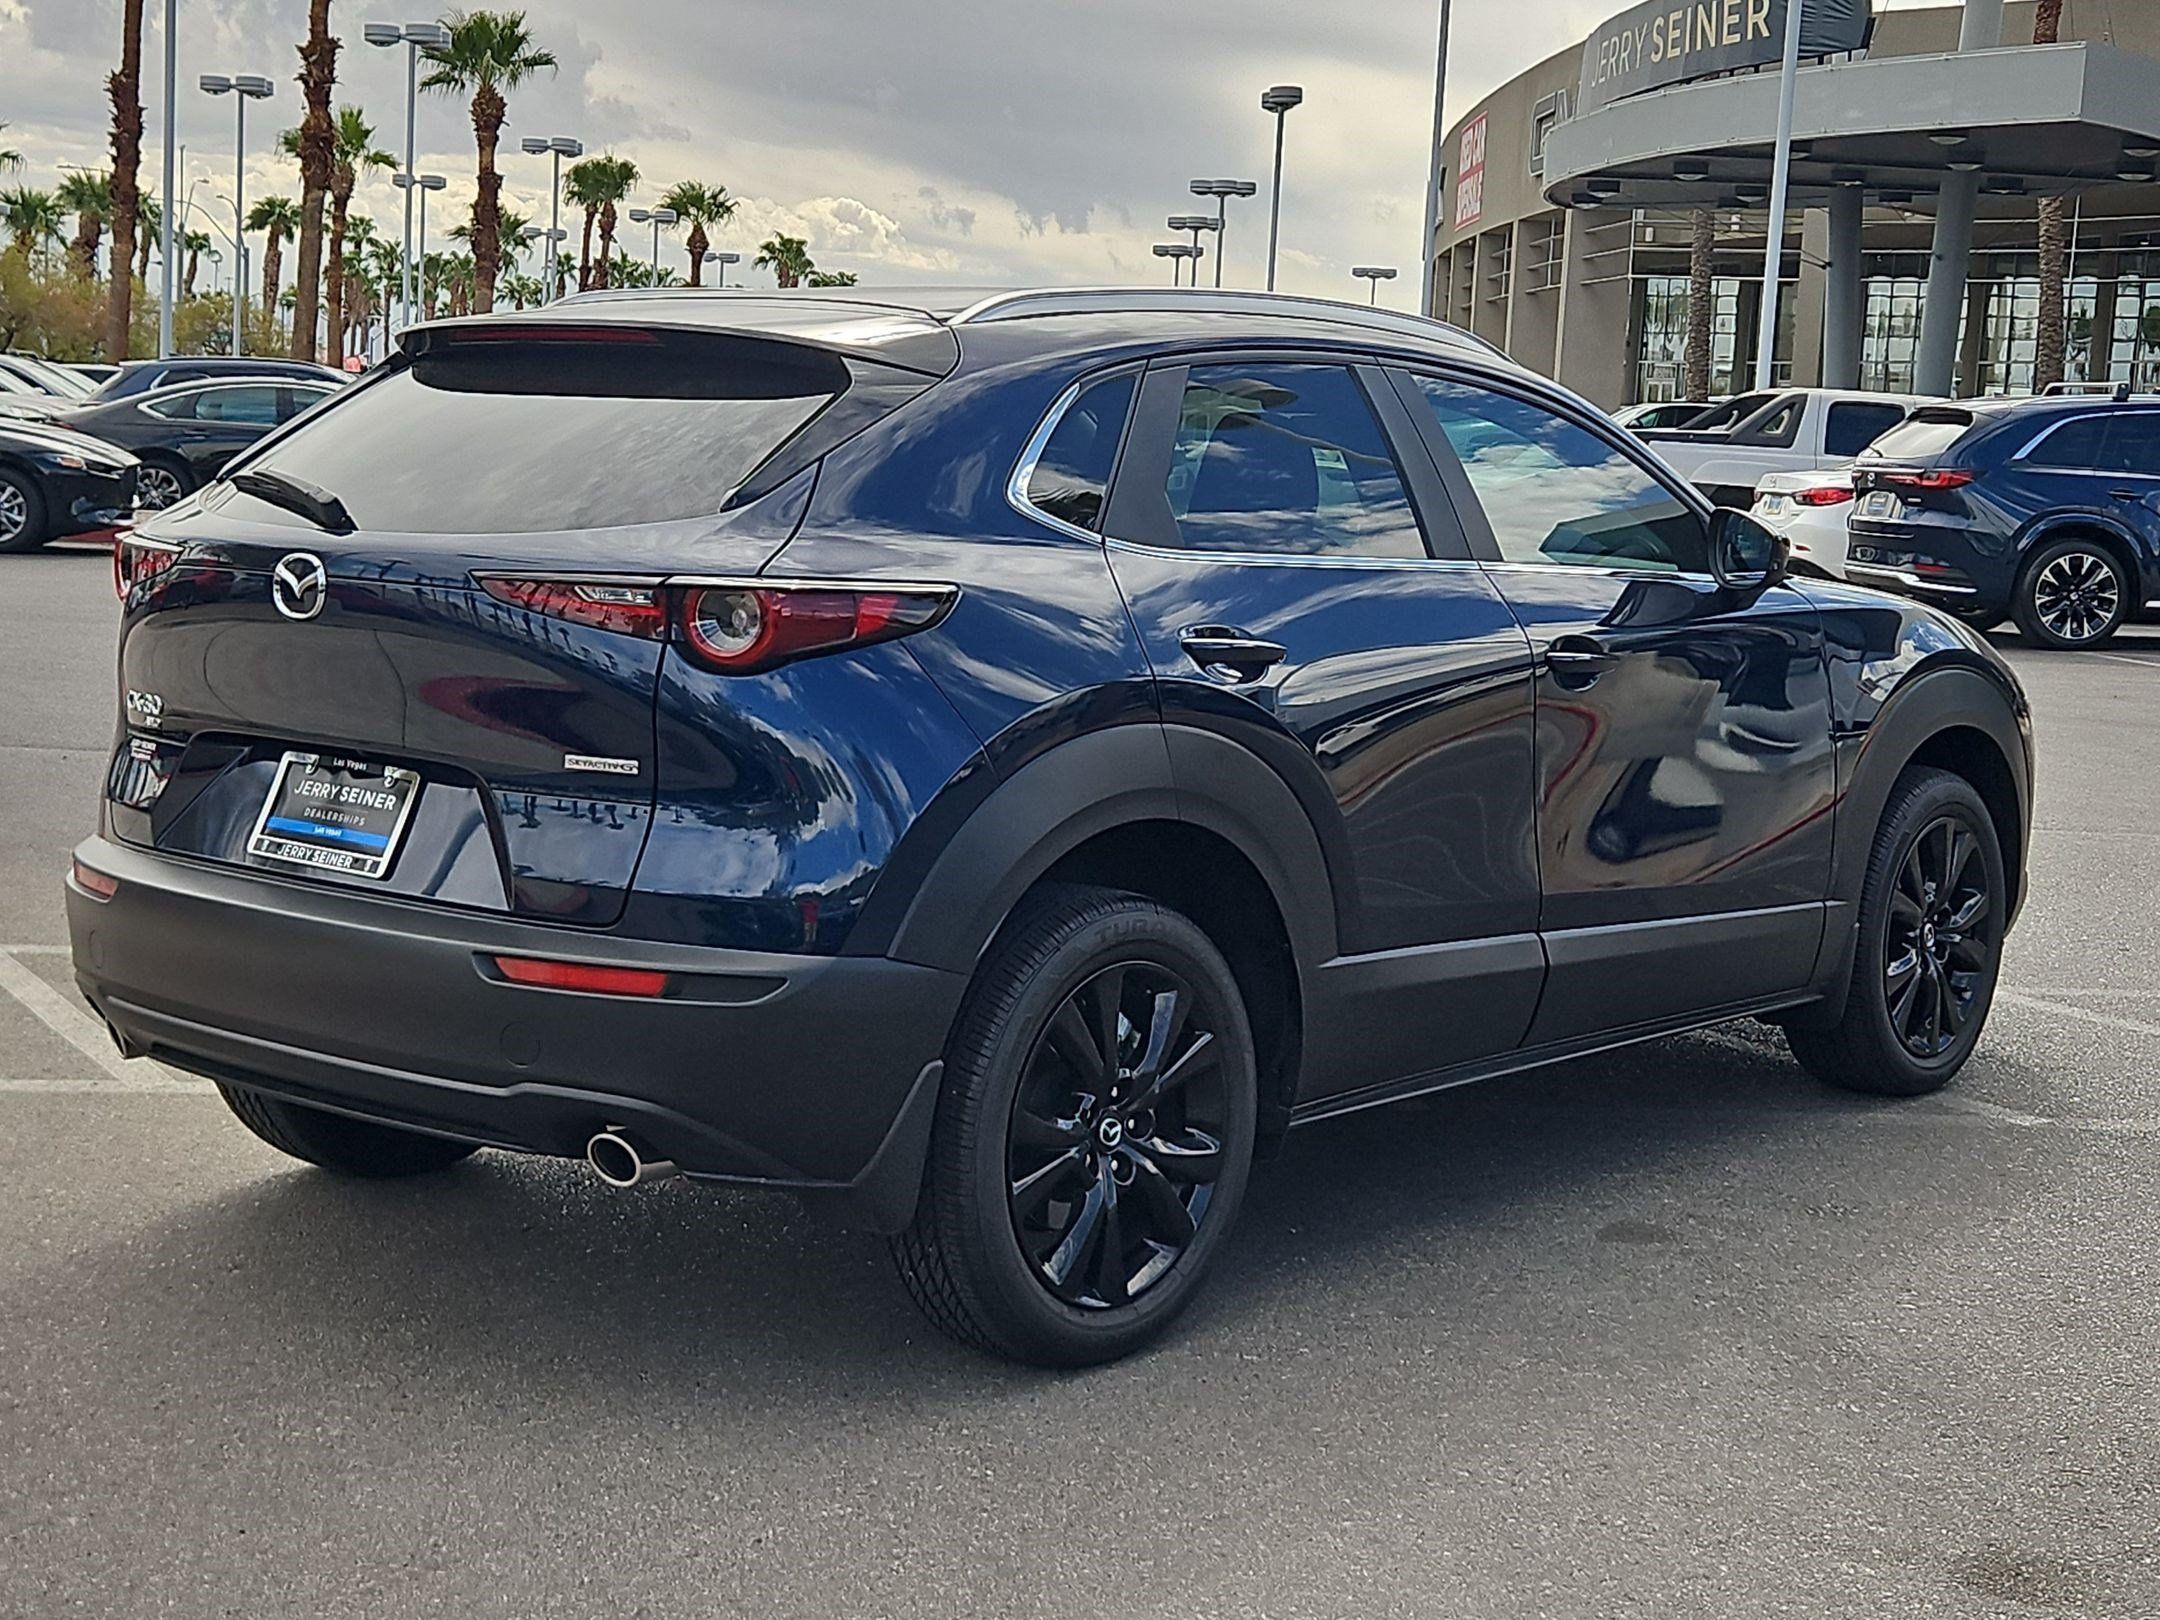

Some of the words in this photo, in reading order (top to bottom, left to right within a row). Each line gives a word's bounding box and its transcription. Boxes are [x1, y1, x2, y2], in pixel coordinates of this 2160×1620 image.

[1592, 22, 1648, 88] JERRY
[1651, 0, 1770, 63] SEINER
[333, 758, 346, 767] Las
[347, 759, 367, 771] Vegas
[294, 779, 342, 801] JERRY
[339, 786, 397, 811] SEINER
[303, 807, 366, 826] DEALERSHIPS
[277, 844, 312, 859] JERRY
[311, 851, 353, 868] SEINER
